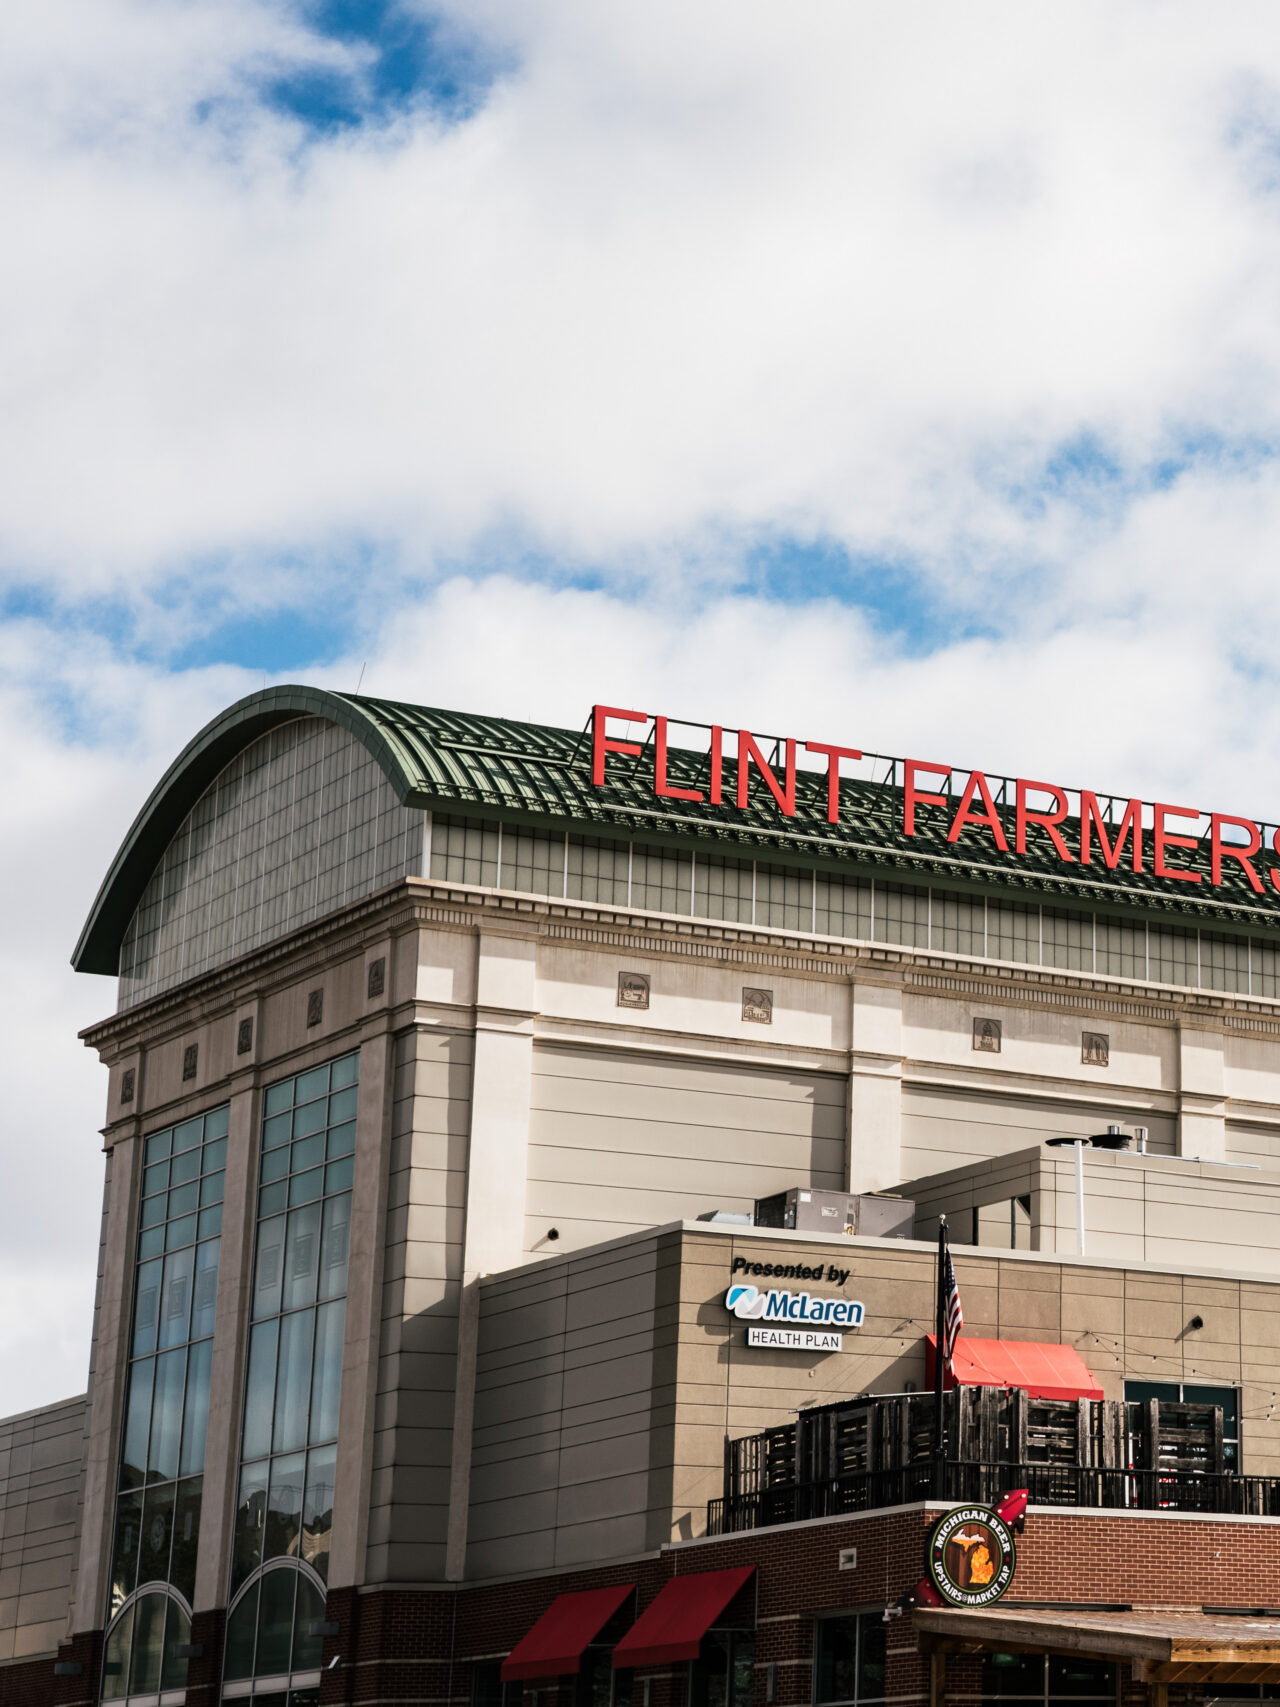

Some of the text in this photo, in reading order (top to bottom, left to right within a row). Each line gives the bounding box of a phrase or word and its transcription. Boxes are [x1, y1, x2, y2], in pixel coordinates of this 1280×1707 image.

[592, 705, 863, 824] FLINT
[733, 1257, 850, 1286] Presented by
[766, 1293, 862, 1324] McLaren
[752, 1331, 839, 1348] HEALTH PLAN
[935, 1510, 1011, 1553] MICHIGAN BEER
[998, 1565, 1011, 1584] TAP
